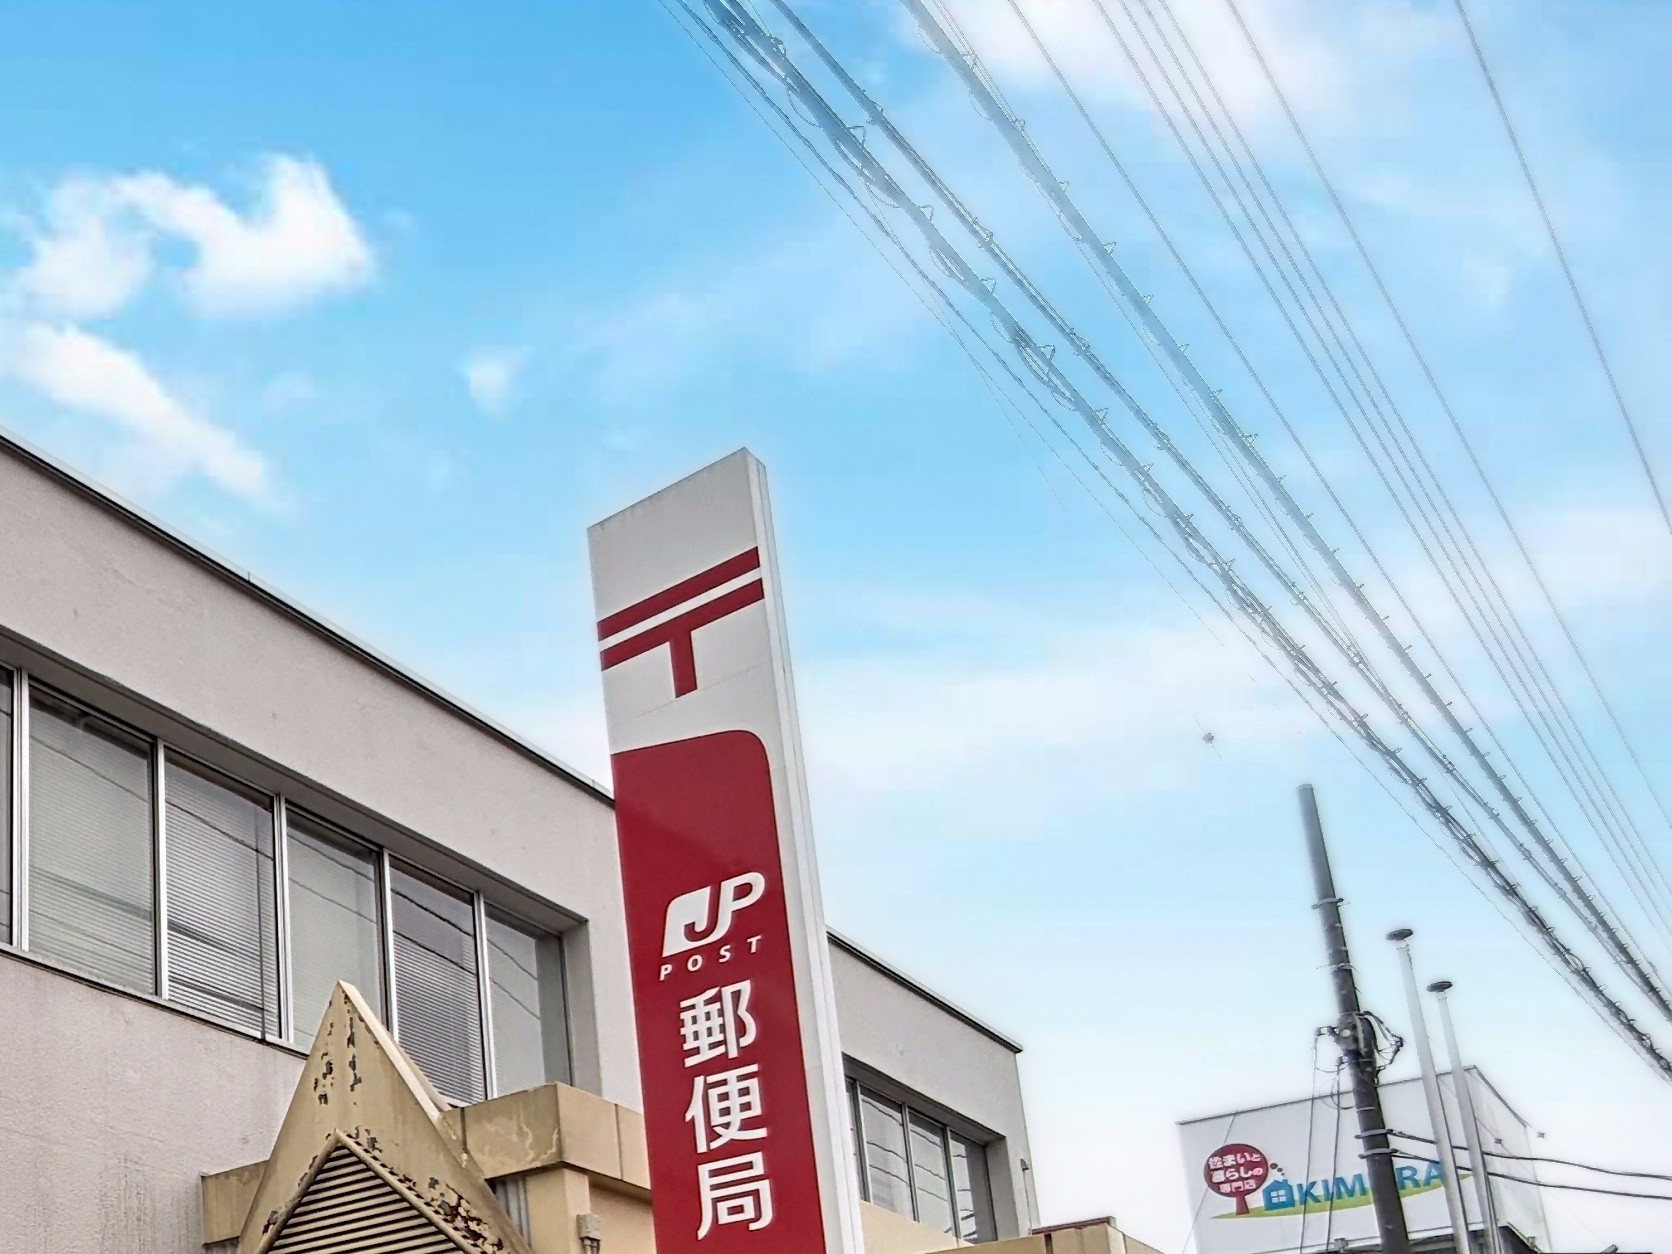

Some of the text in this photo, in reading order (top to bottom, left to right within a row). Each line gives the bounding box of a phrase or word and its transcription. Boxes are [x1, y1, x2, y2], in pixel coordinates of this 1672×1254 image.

[662, 872, 766, 957] JP
[659, 935, 762, 981] POST
[679, 979, 774, 1241] 郵便局
[1297, 1161, 1445, 1206] KIMRA
